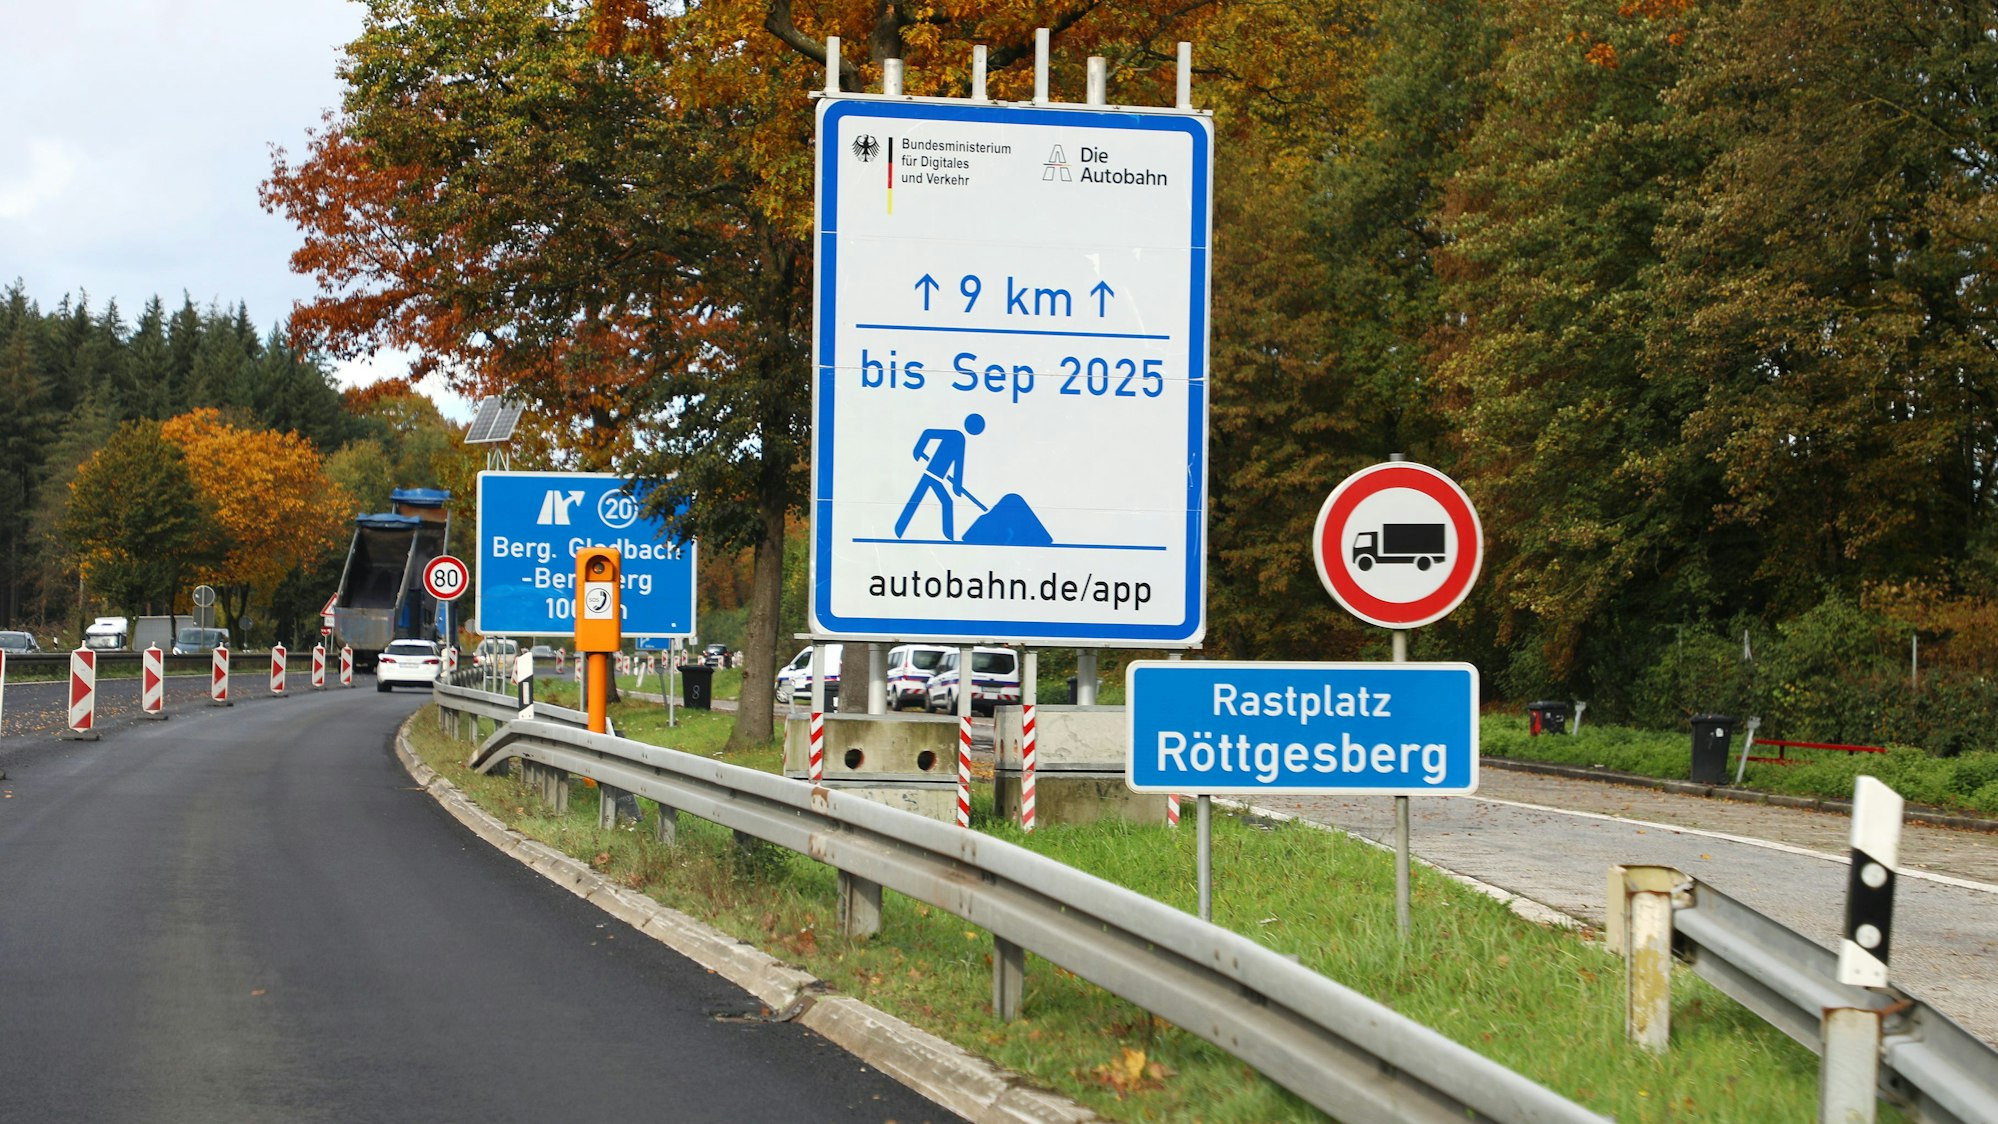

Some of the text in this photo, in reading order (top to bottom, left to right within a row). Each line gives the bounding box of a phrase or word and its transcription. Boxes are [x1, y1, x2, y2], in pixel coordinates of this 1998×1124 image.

[902, 137, 1011, 154] Bundesministerium
[1080, 146, 1109, 164] Die
[901, 154, 970, 174] für Digitales
[901, 172, 970, 186] und Verkehr
[1080, 167, 1168, 186] Autobahn
[960, 274, 1072, 317] 9 km
[861, 348, 1164, 404] bis Sep 2025
[604, 497, 632, 520] 20
[493, 536, 557, 563] Berg.
[434, 569, 458, 588] 80
[869, 570, 1152, 611] autobahn.de/app
[1213, 683, 1391, 725] Rastplatz
[1156, 731, 1447, 785] Röttgesberg
